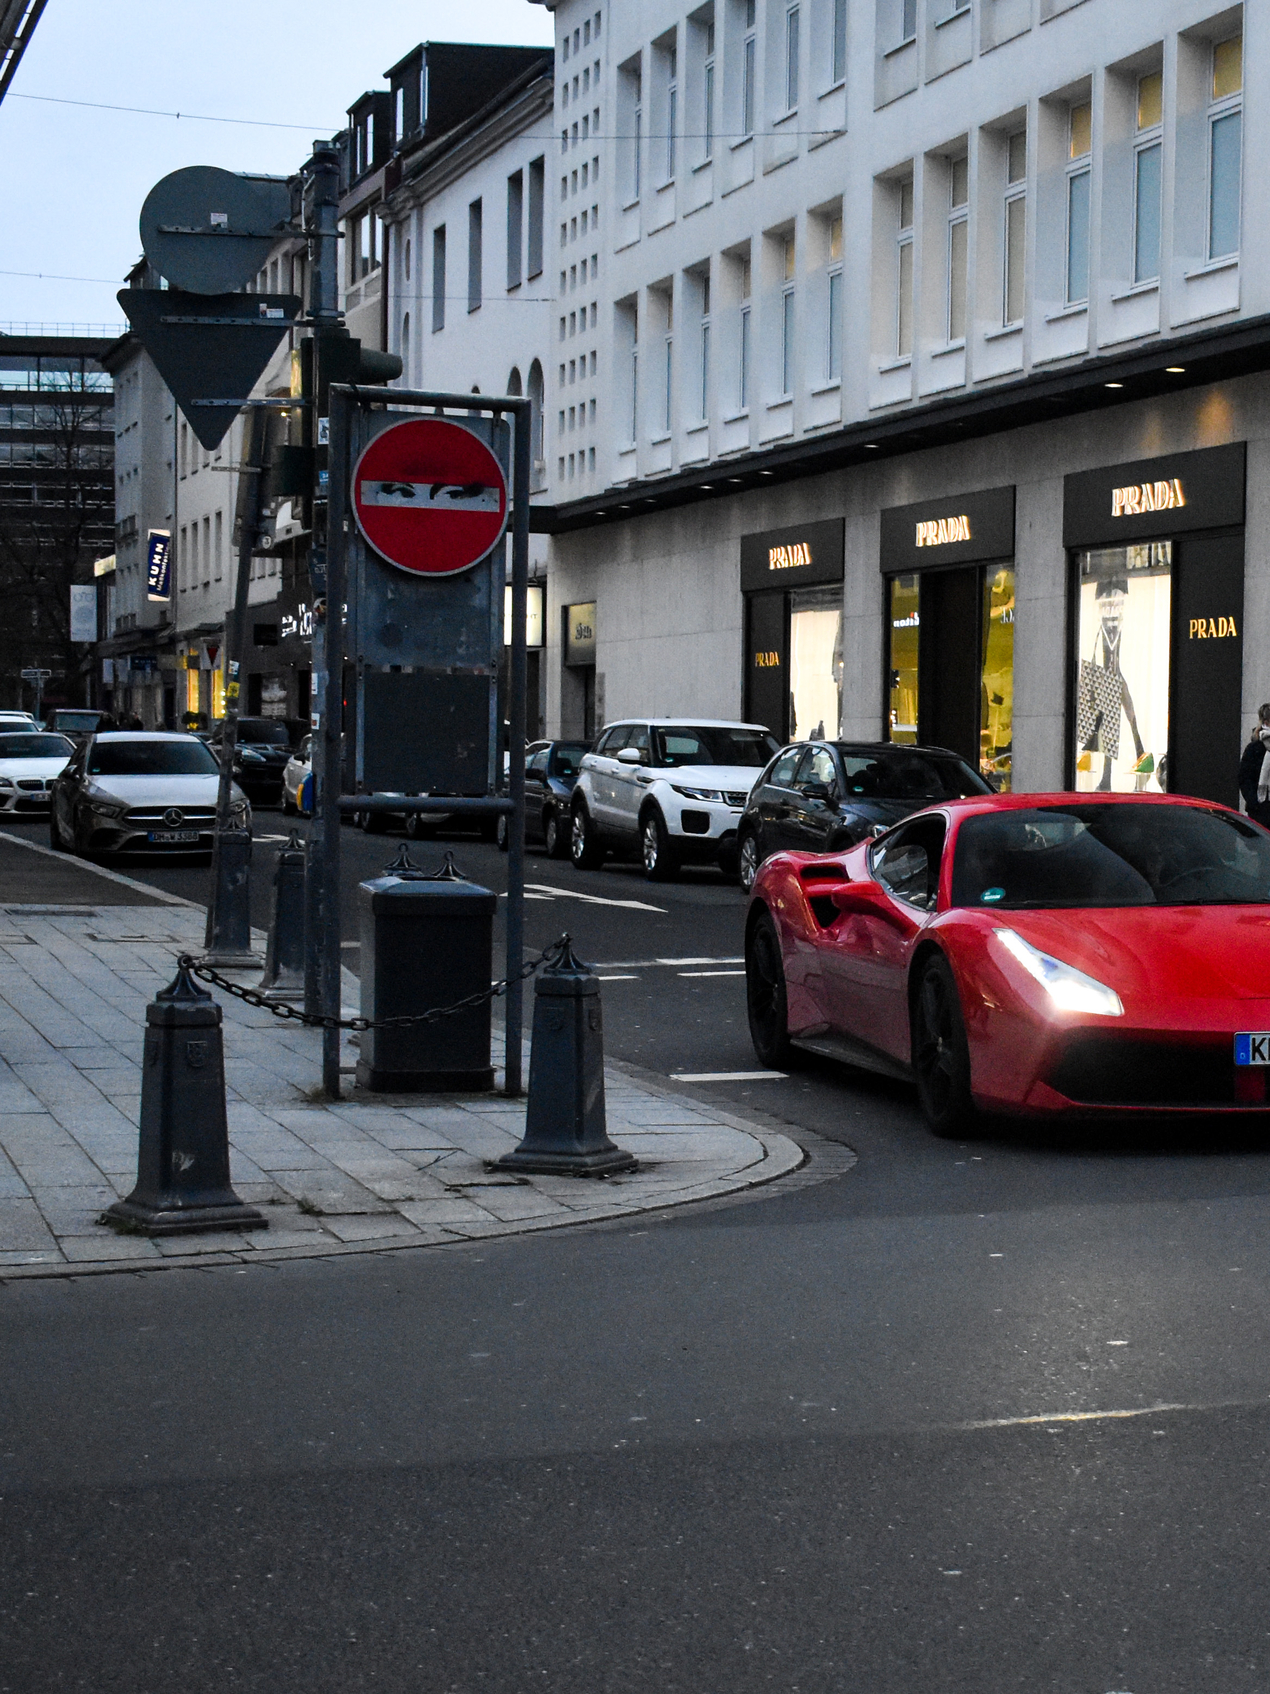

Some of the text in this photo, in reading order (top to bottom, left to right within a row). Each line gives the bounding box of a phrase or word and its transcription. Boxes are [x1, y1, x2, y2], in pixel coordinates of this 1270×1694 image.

[1111, 478, 1186, 517] PRADA
[915, 515, 971, 548] PRADA
[148, 543, 164, 586] KUHN
[769, 542, 812, 570] PRADA
[1189, 616, 1237, 639] PRADA
[755, 652, 780, 668] PRADA
